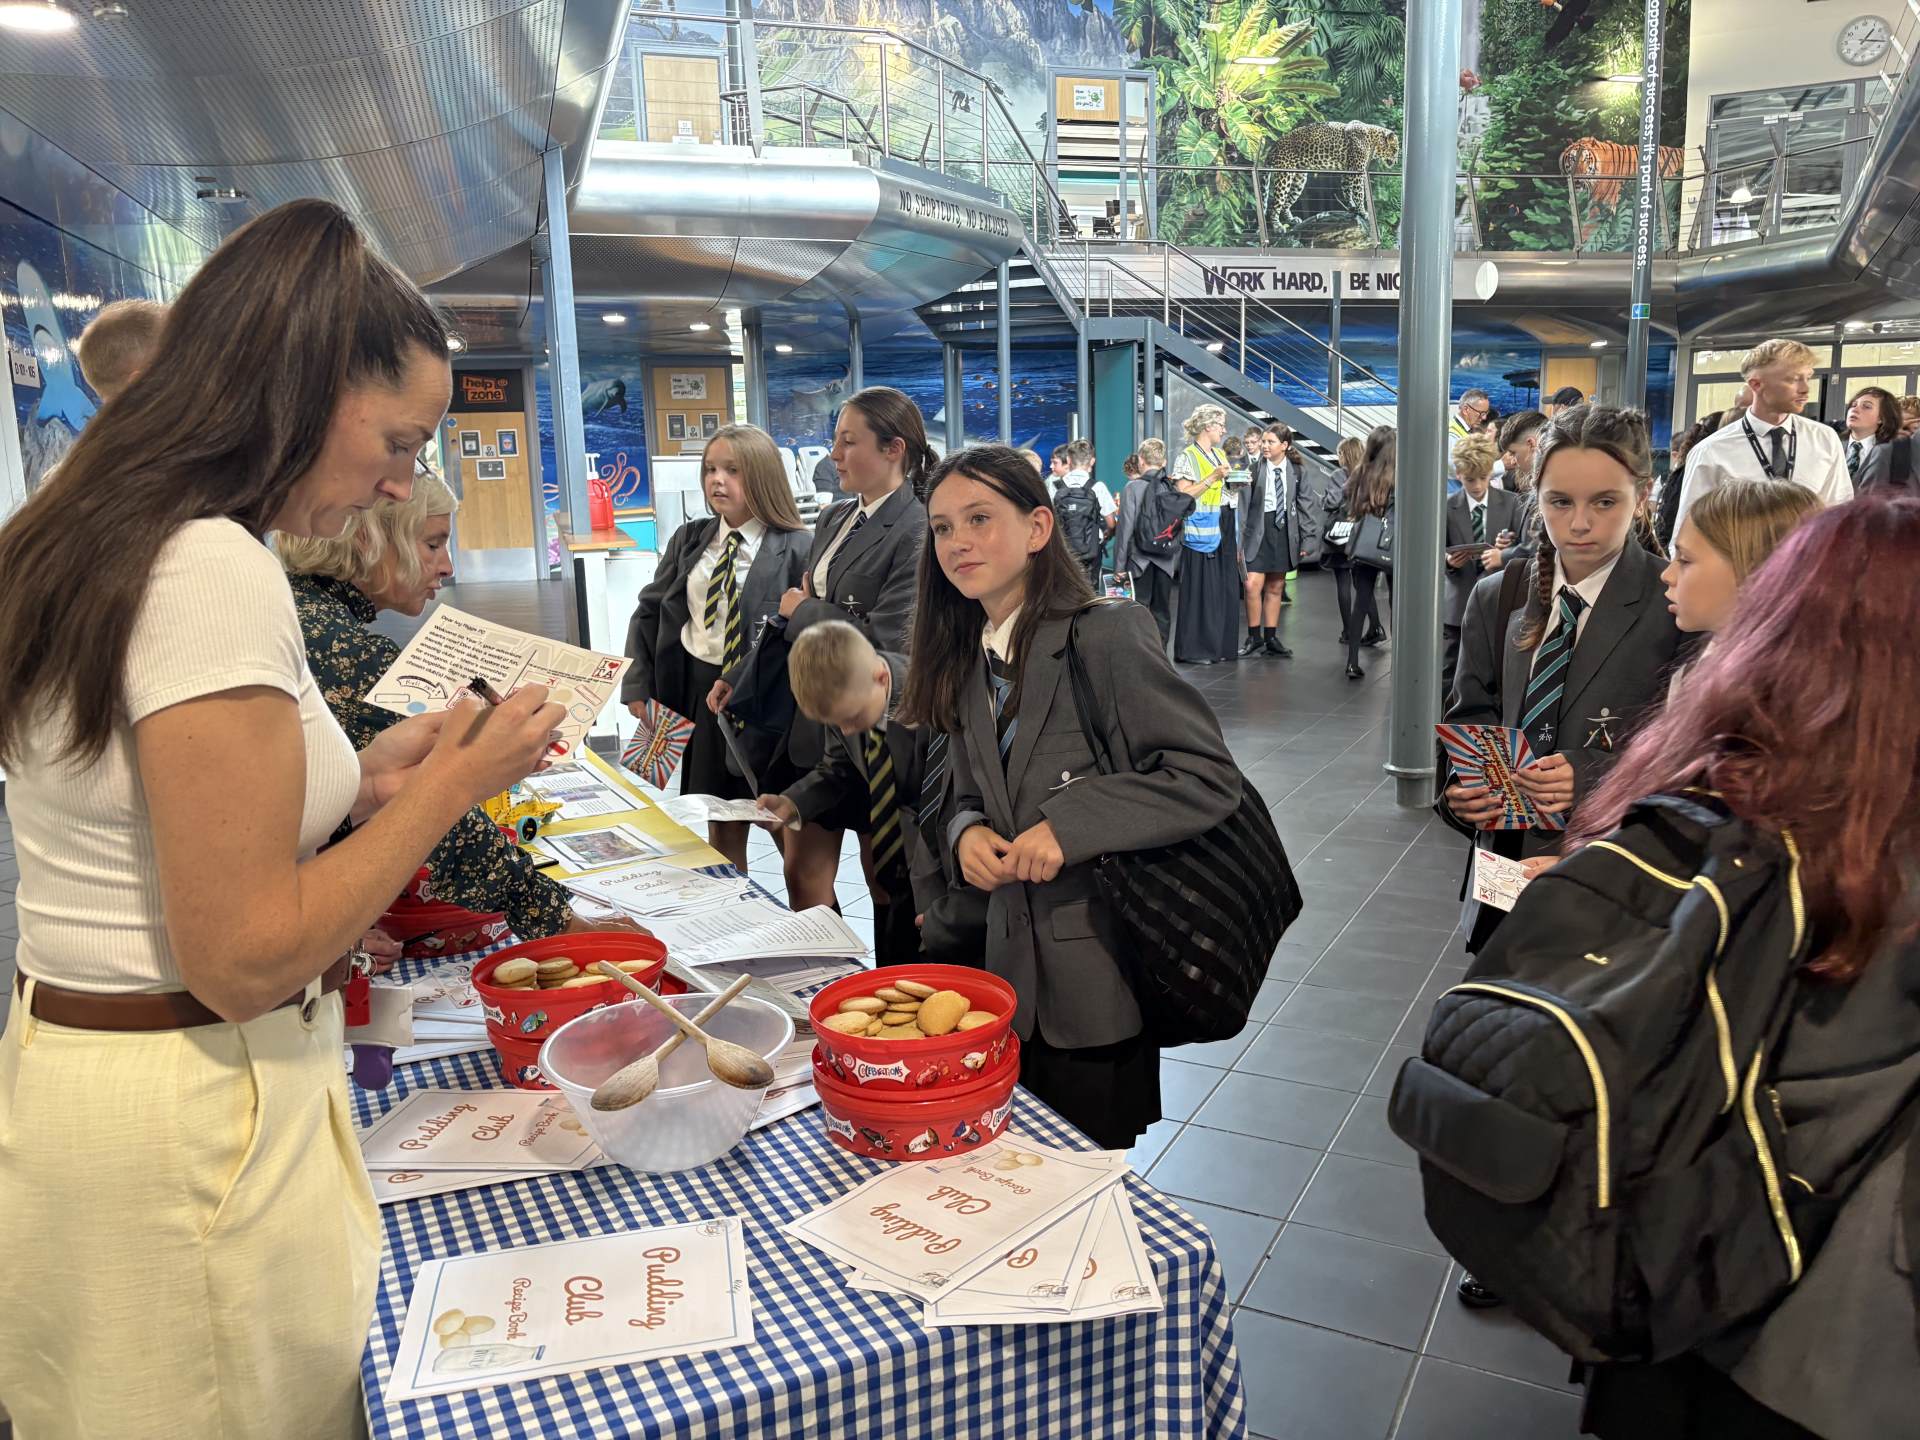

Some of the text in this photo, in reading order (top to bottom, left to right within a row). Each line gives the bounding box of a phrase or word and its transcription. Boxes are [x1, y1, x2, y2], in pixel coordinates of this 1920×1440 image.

[1647, 65, 1659, 77] of
[1643, 81, 1656, 140] success,
[1640, 165, 1652, 192] part
[900, 189, 1009, 238] NO SHORTCUTS, NO EXCUSES
[1640, 195, 1652, 209] of
[1637, 212, 1649, 270] success.
[1202, 266, 1265, 295] WORK
[1272, 272, 1328, 294] HARD,
[1350, 272, 1370, 291] BE
[465, 377, 493, 390] help
[470, 390, 502, 400] zone
[434, 625, 458, 637] Welcome
[480, 657, 500, 668] Explore
[600, 869, 663, 888] Pudding
[634, 879, 672, 891] Club
[858, 1063, 904, 1078] CELEBRATIONS
[399, 1103, 477, 1150] Pudding
[472, 1113, 515, 1141] Club
[962, 1166, 1032, 1195] Recipe Book
[926, 1185, 992, 1215] Club
[869, 1203, 962, 1255] Pudding
[564, 1276, 604, 1326] Club
[628, 1246, 684, 1330] Pudding
[504, 1277, 531, 1341] Recipe Book
